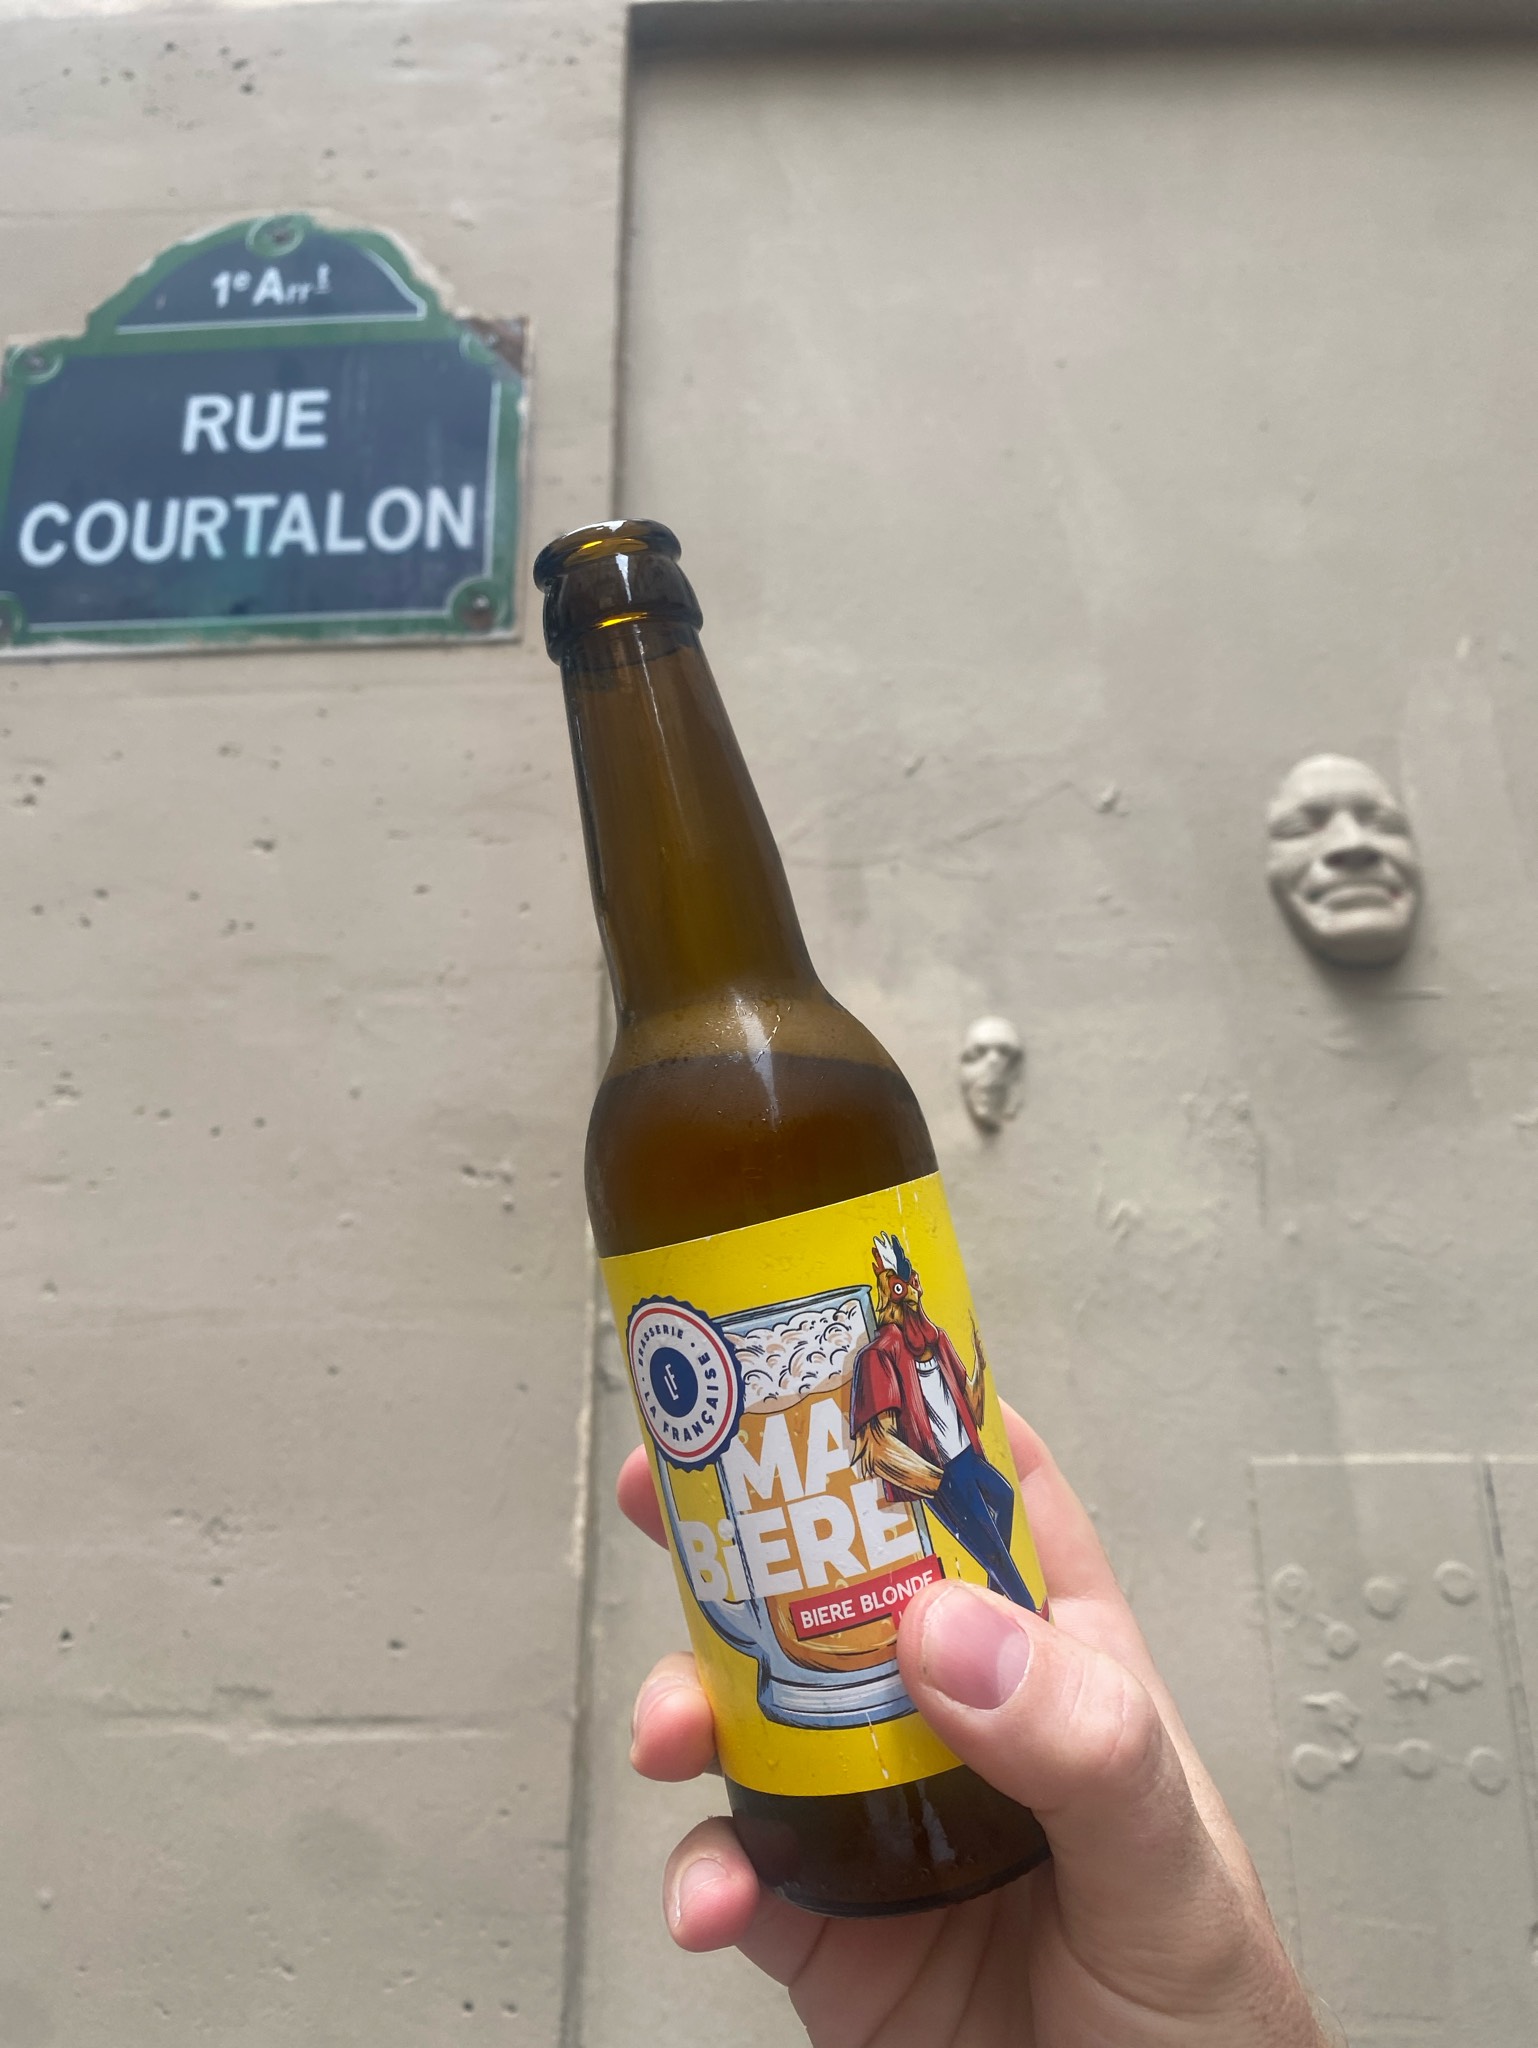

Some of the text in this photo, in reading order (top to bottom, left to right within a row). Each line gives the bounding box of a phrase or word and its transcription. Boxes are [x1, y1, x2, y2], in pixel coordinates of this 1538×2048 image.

[181, 388, 330, 454] RUE
[18, 484, 477, 567] COURTALON
[638, 1324, 684, 1367] BRASSERIE
[662, 1352, 720, 1443] FRANÇAISE
[720, 1398, 862, 1513] MA
[800, 1599, 856, 1629] BIERE
